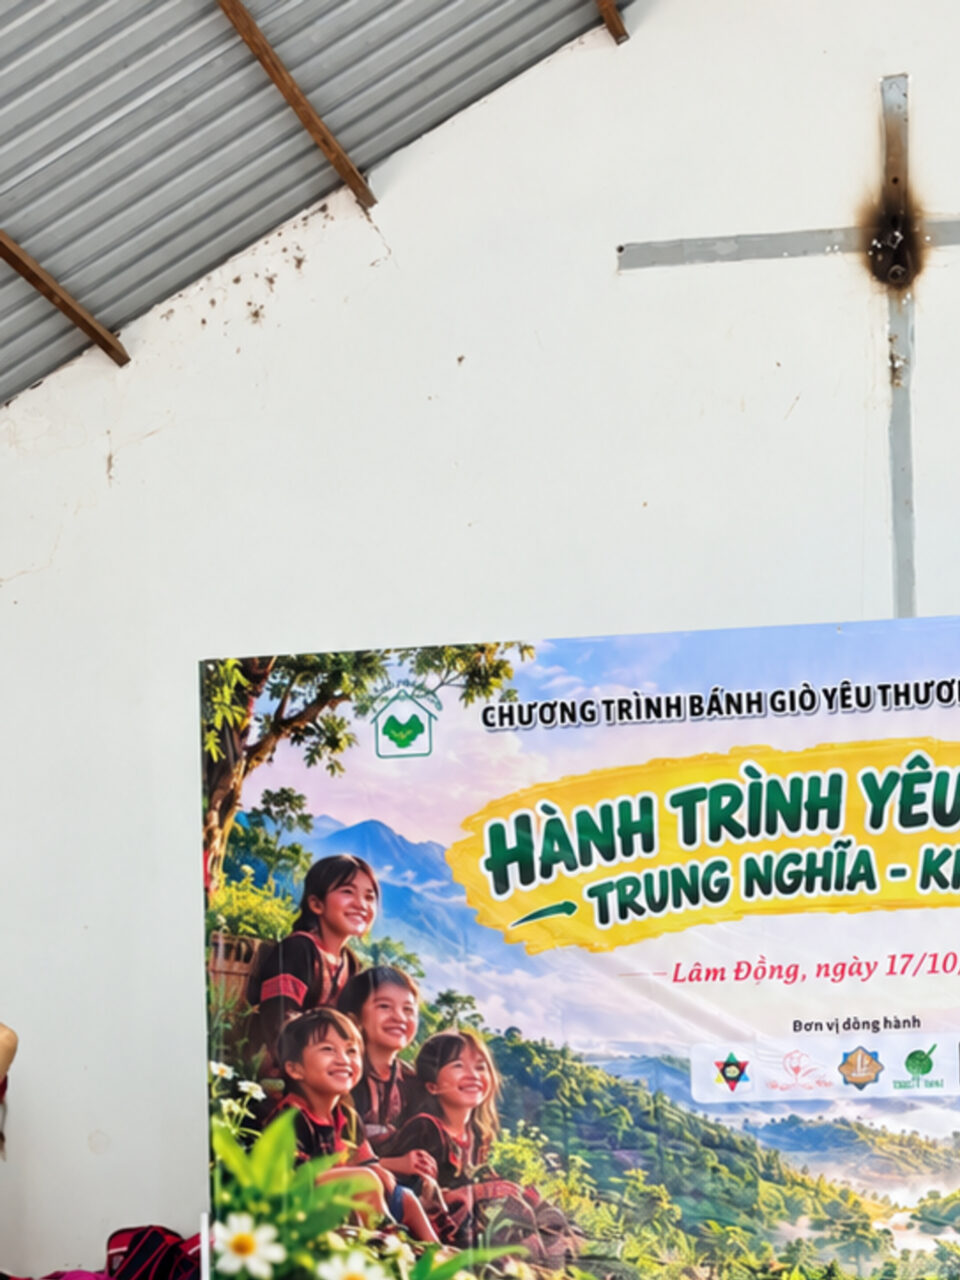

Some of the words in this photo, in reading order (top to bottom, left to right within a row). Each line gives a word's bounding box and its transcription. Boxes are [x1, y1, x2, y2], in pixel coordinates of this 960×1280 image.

[482, 699, 596, 728] CHƯƠNG
[603, 691, 682, 721] TRÌNH
[690, 686, 763, 716] BÁNH
[770, 683, 817, 713] GIÒ
[822, 680, 872, 709] YÊU
[484, 796, 655, 895] HÀNH
[669, 766, 844, 846] TRÌNH
[587, 861, 730, 926] TRUNG
[744, 839, 876, 898] NGHĨA
[672, 961, 726, 983] Lâm
[733, 954, 807, 986] Đồng,
[816, 954, 878, 983] ngày
[826, 1018, 840, 1034] vị
[883, 1015, 921, 1030] hành
